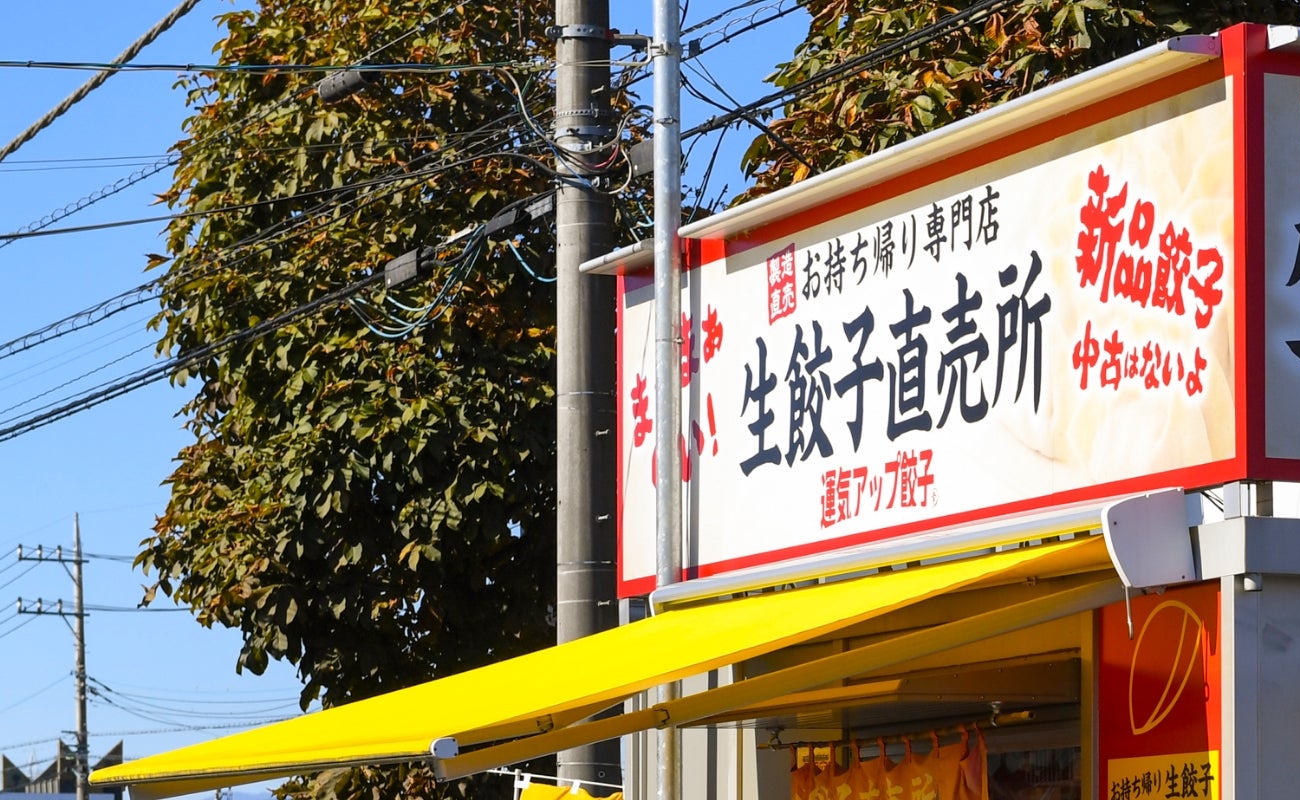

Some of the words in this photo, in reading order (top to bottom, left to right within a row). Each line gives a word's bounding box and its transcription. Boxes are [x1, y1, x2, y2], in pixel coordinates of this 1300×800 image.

[769, 251, 794, 286] 製造
[801, 185, 1000, 300] お持ち帰り専門店
[1076, 164, 1223, 329] 新品餃子
[770, 282, 795, 317] 直売
[740, 250, 1051, 477] 生餃子直売所
[1072, 320, 1207, 397] 中古はないよ
[820, 449, 934, 530] 運気アップ餃子
